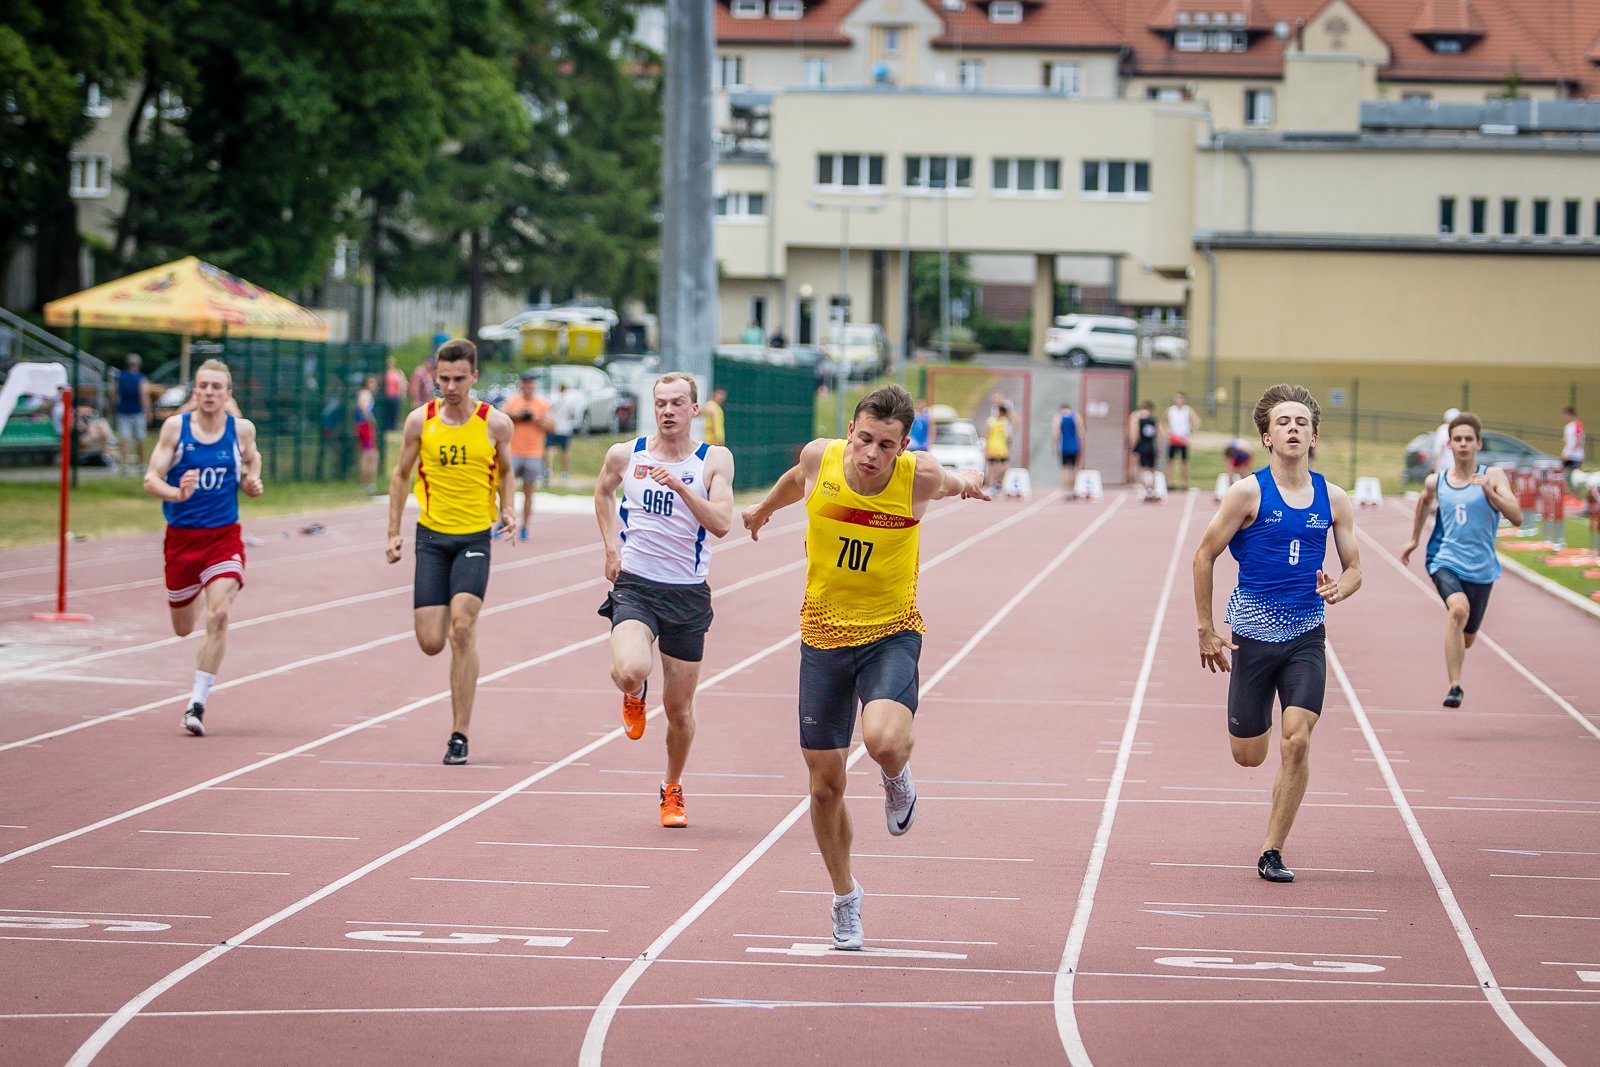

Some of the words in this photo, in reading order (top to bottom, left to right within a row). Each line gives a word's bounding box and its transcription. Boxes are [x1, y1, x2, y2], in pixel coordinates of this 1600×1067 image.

[439, 445, 467, 466] 521
[643, 489, 675, 517] 966
[872, 513, 888, 521] MKS
[1455, 503, 1468, 526] 6
[836, 536, 874, 573] 707
[1288, 539, 1301, 566] 9
[344, 929, 575, 948] 5
[1153, 955, 1387, 974] 3
